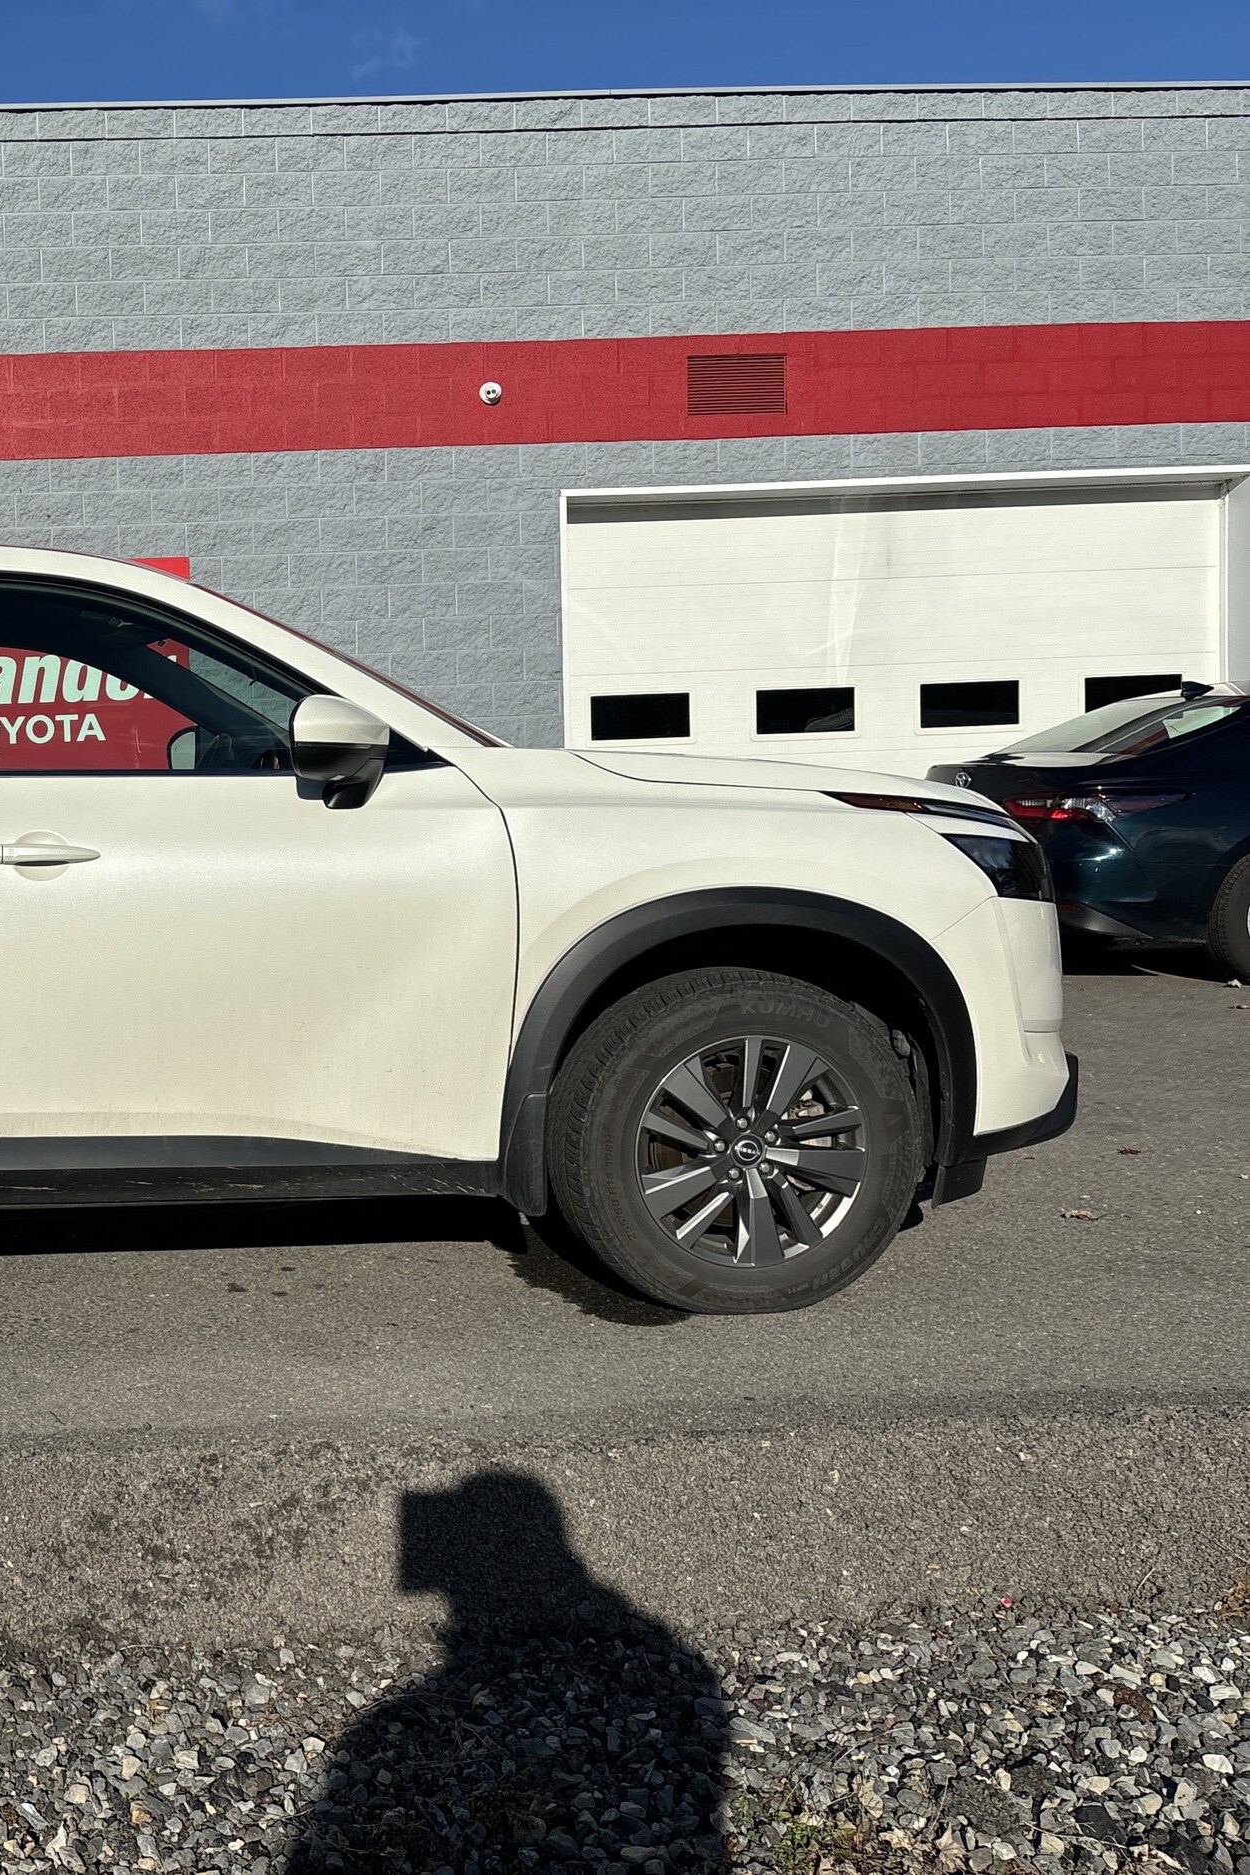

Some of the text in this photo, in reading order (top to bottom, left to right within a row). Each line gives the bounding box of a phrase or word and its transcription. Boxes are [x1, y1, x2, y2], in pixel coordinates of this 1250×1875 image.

[741, 993, 831, 1028] KUMHO
[605, 1173, 618, 1197] R18
[611, 1199, 638, 1241] 255/60
